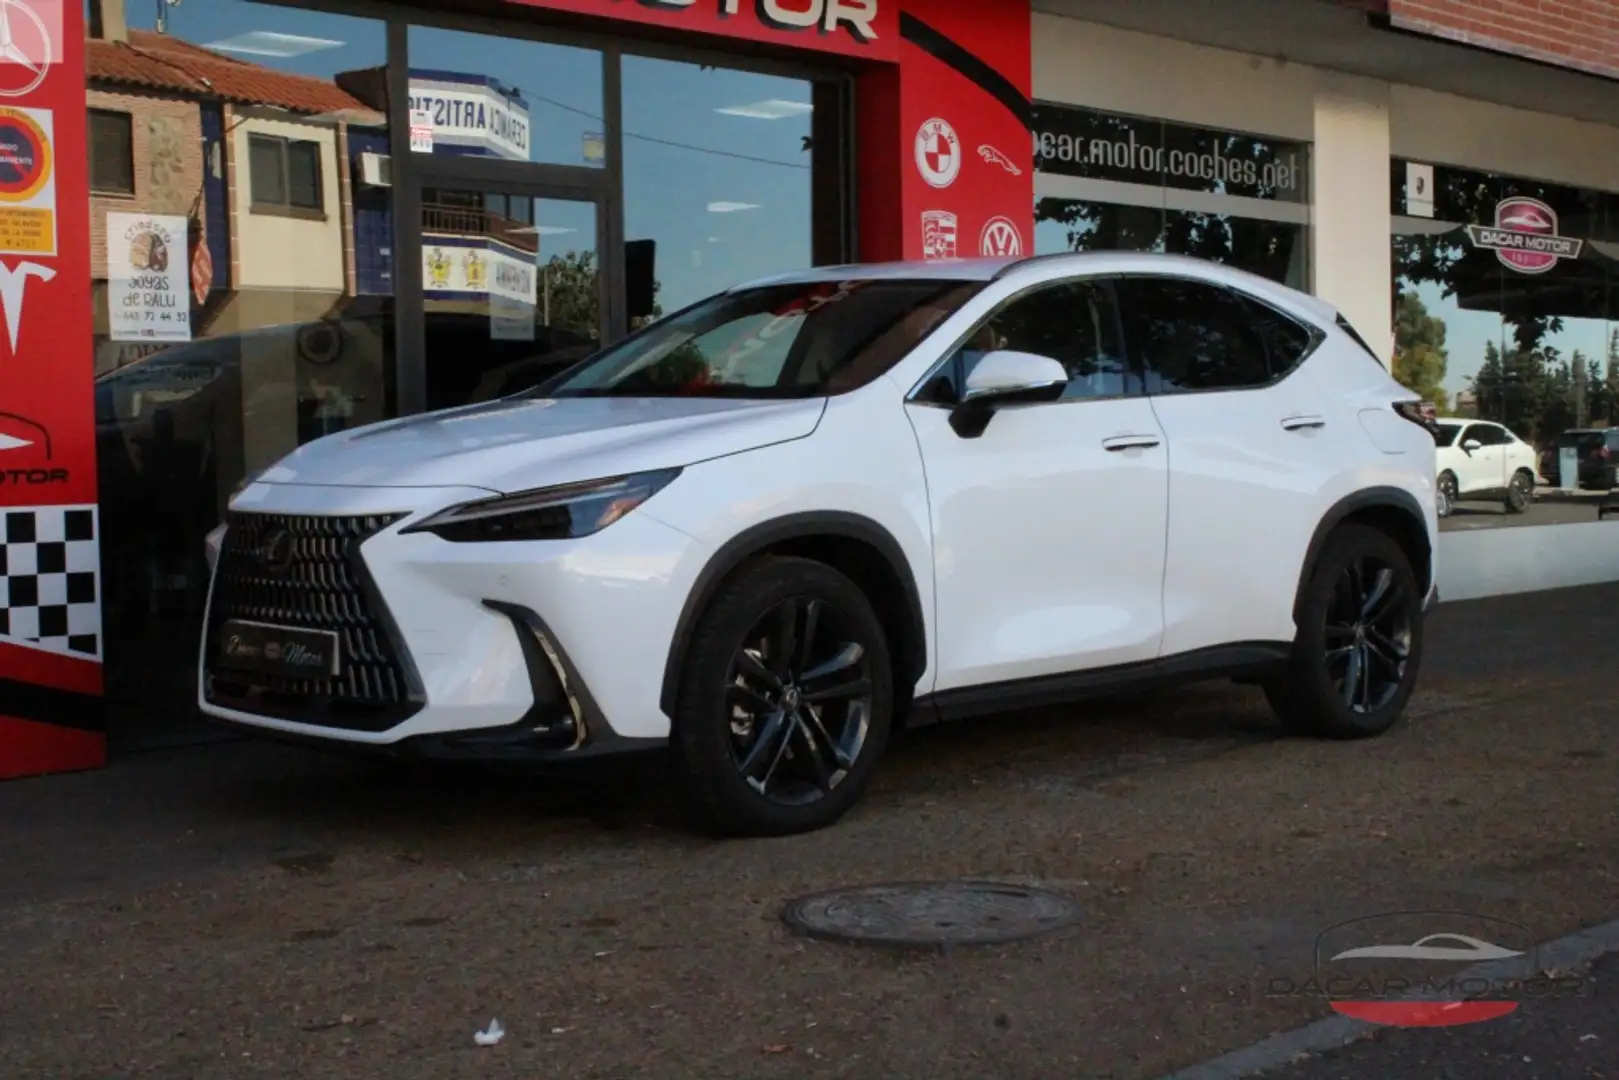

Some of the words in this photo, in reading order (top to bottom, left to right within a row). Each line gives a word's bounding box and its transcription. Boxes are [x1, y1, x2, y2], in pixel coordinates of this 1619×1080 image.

[1480, 230, 1523, 247] DACAR
[1525, 236, 1572, 253] MOTOR
[0, 468, 69, 485] TOR
